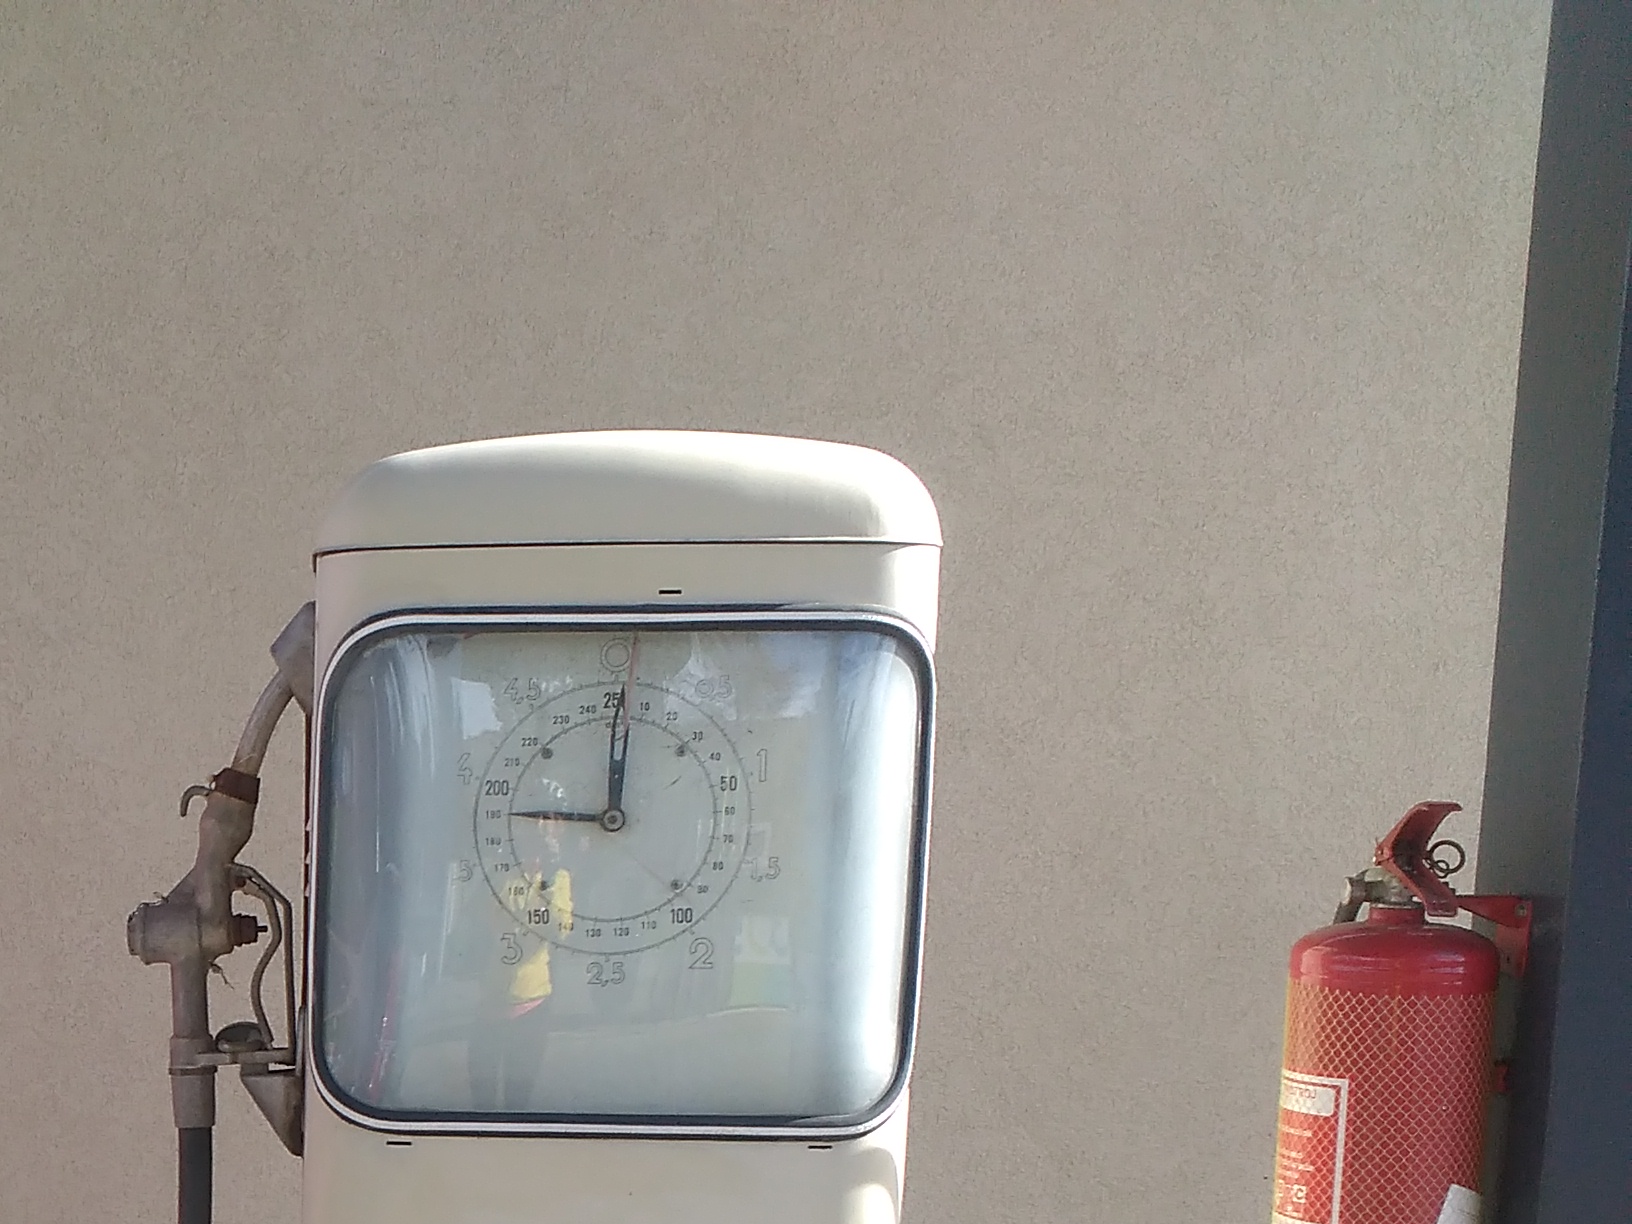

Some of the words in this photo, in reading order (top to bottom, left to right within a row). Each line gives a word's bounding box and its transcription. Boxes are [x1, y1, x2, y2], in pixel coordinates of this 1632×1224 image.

[503, 677, 541, 705] 4,5
[603, 691, 625, 709] 25
[579, 705, 597, 715] 240
[640, 701, 650, 712] 10
[553, 715, 570, 725] 230
[666, 711, 678, 721] 20
[692, 731, 703, 741] 30
[521, 737, 538, 747] 220
[709, 751, 721, 761] 40
[504, 758, 520, 767] 210
[756, 748, 767, 783] 1
[485, 780, 510, 796] 200
[720, 776, 737, 791] 50
[724, 806, 735, 815] 60
[485, 837, 501, 846] 180
[723, 834, 734, 844] 70
[494, 863, 510, 872] 170
[713, 861, 724, 871] 80
[750, 857, 781, 882] 1,5
[527, 909, 550, 925] 150
[671, 908, 693, 924] 100
[641, 920, 657, 930] 110
[585, 928, 601, 937] 130
[613, 927, 630, 937] 120
[501, 932, 523, 965] 3
[688, 937, 714, 970] 2
[586, 961, 626, 988] 2,5
